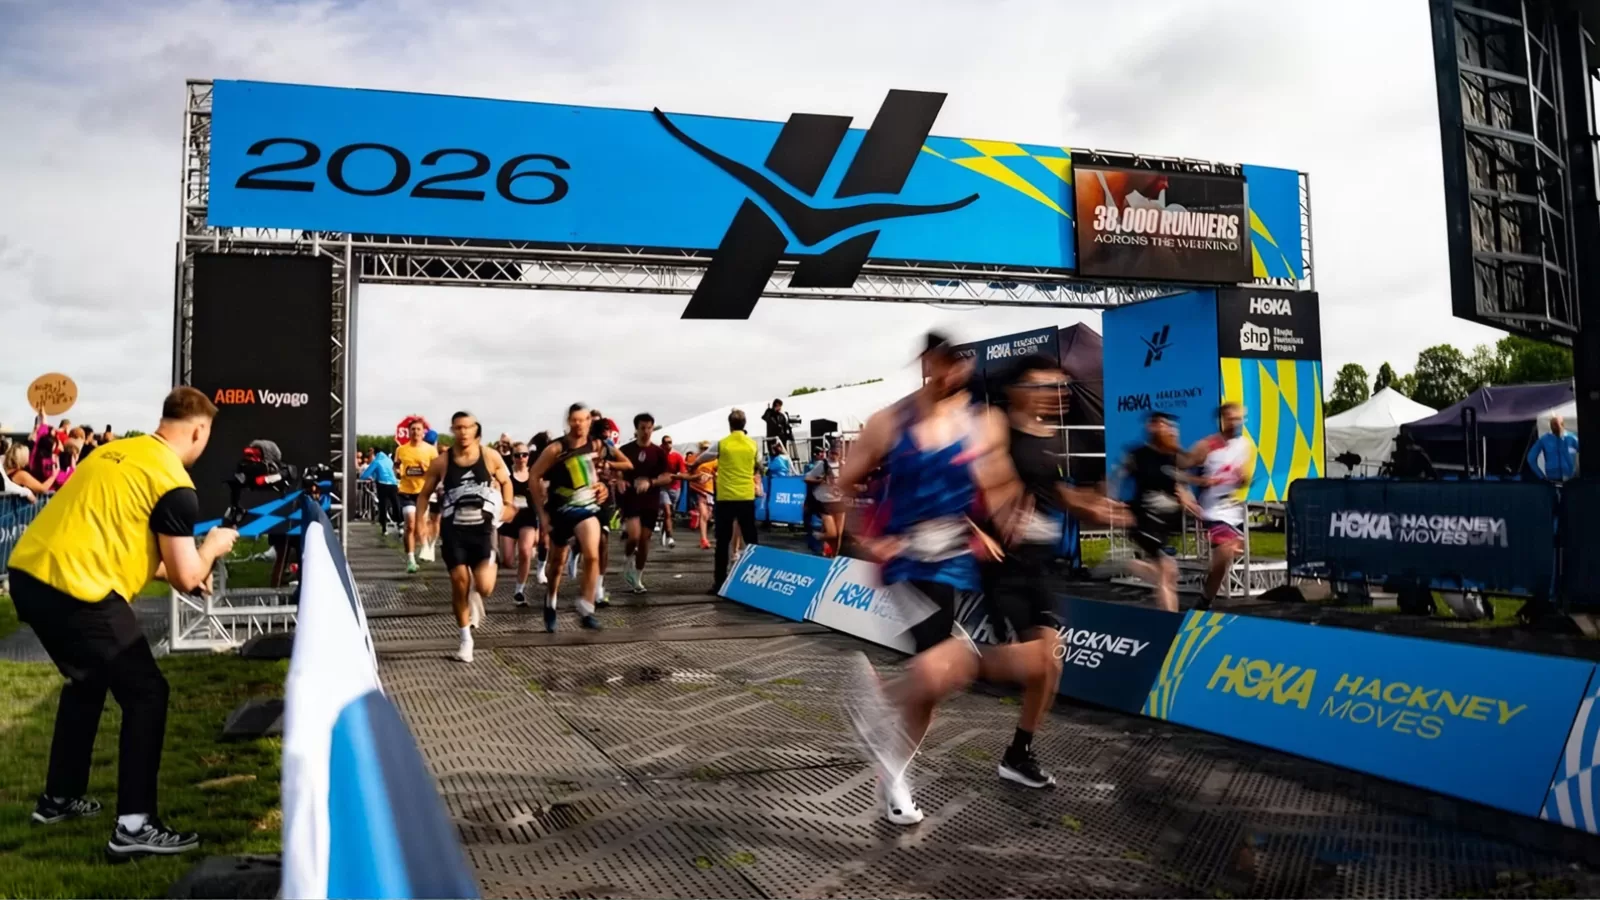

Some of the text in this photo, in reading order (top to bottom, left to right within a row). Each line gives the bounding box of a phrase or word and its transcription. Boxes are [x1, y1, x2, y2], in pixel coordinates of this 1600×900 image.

[234, 137, 571, 205] 2026
[1093, 205, 1239, 240] 38,000 RUNNERS
[1249, 297, 1292, 316] HOKA
[1243, 327, 1268, 348] shp
[214, 388, 255, 404] ABBA
[1117, 392, 1152, 412] HOKA
[1329, 511, 1393, 540] HOKA
[1401, 513, 1502, 533] HACKNEY
[1399, 528, 1468, 546] MOVES
[1052, 643, 1104, 669] OVES
[1206, 654, 1317, 710] HOKA
[1333, 673, 1528, 725] HACKNEY
[1319, 695, 1445, 740] MOVES
